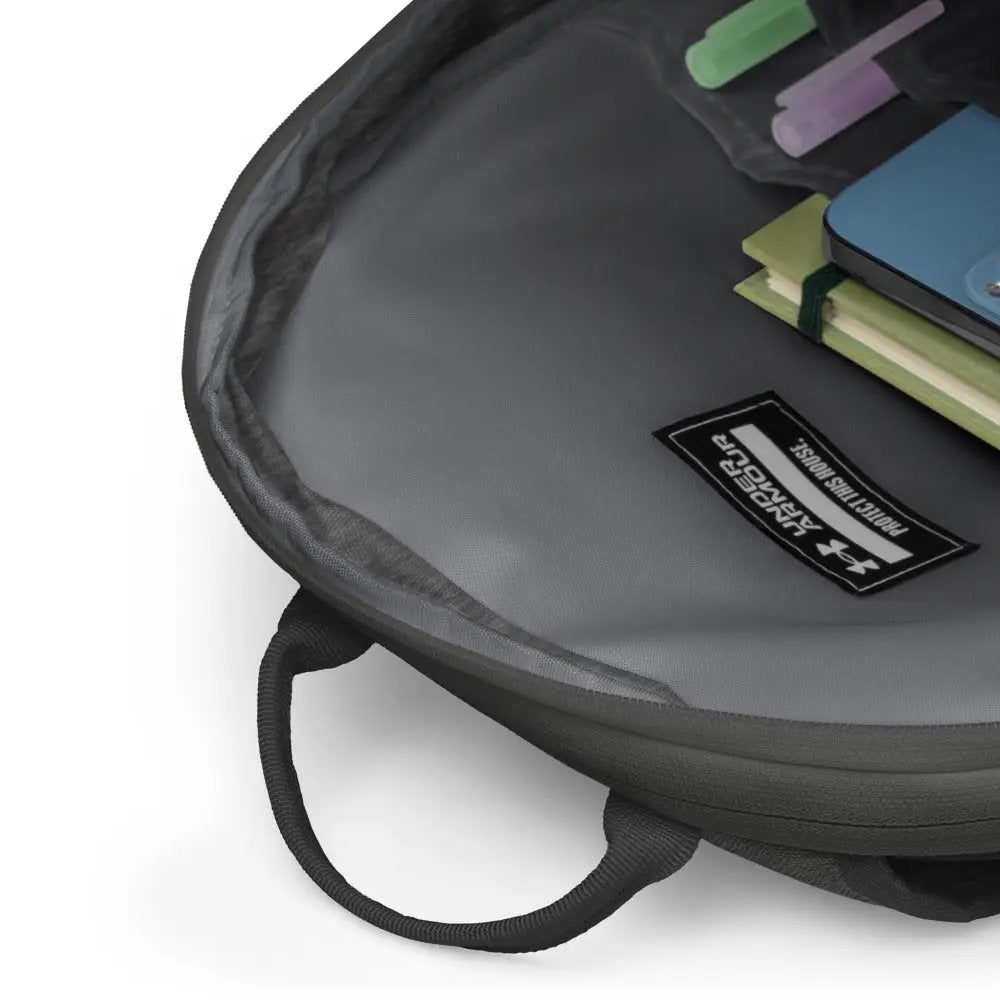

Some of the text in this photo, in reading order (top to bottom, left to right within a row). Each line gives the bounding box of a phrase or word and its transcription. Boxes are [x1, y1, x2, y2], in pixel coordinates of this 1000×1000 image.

[711, 433, 823, 530] ARMOUR
[719, 458, 807, 537] UNDER
[790, 437, 909, 537] PROTECT THIS HOUSE.
